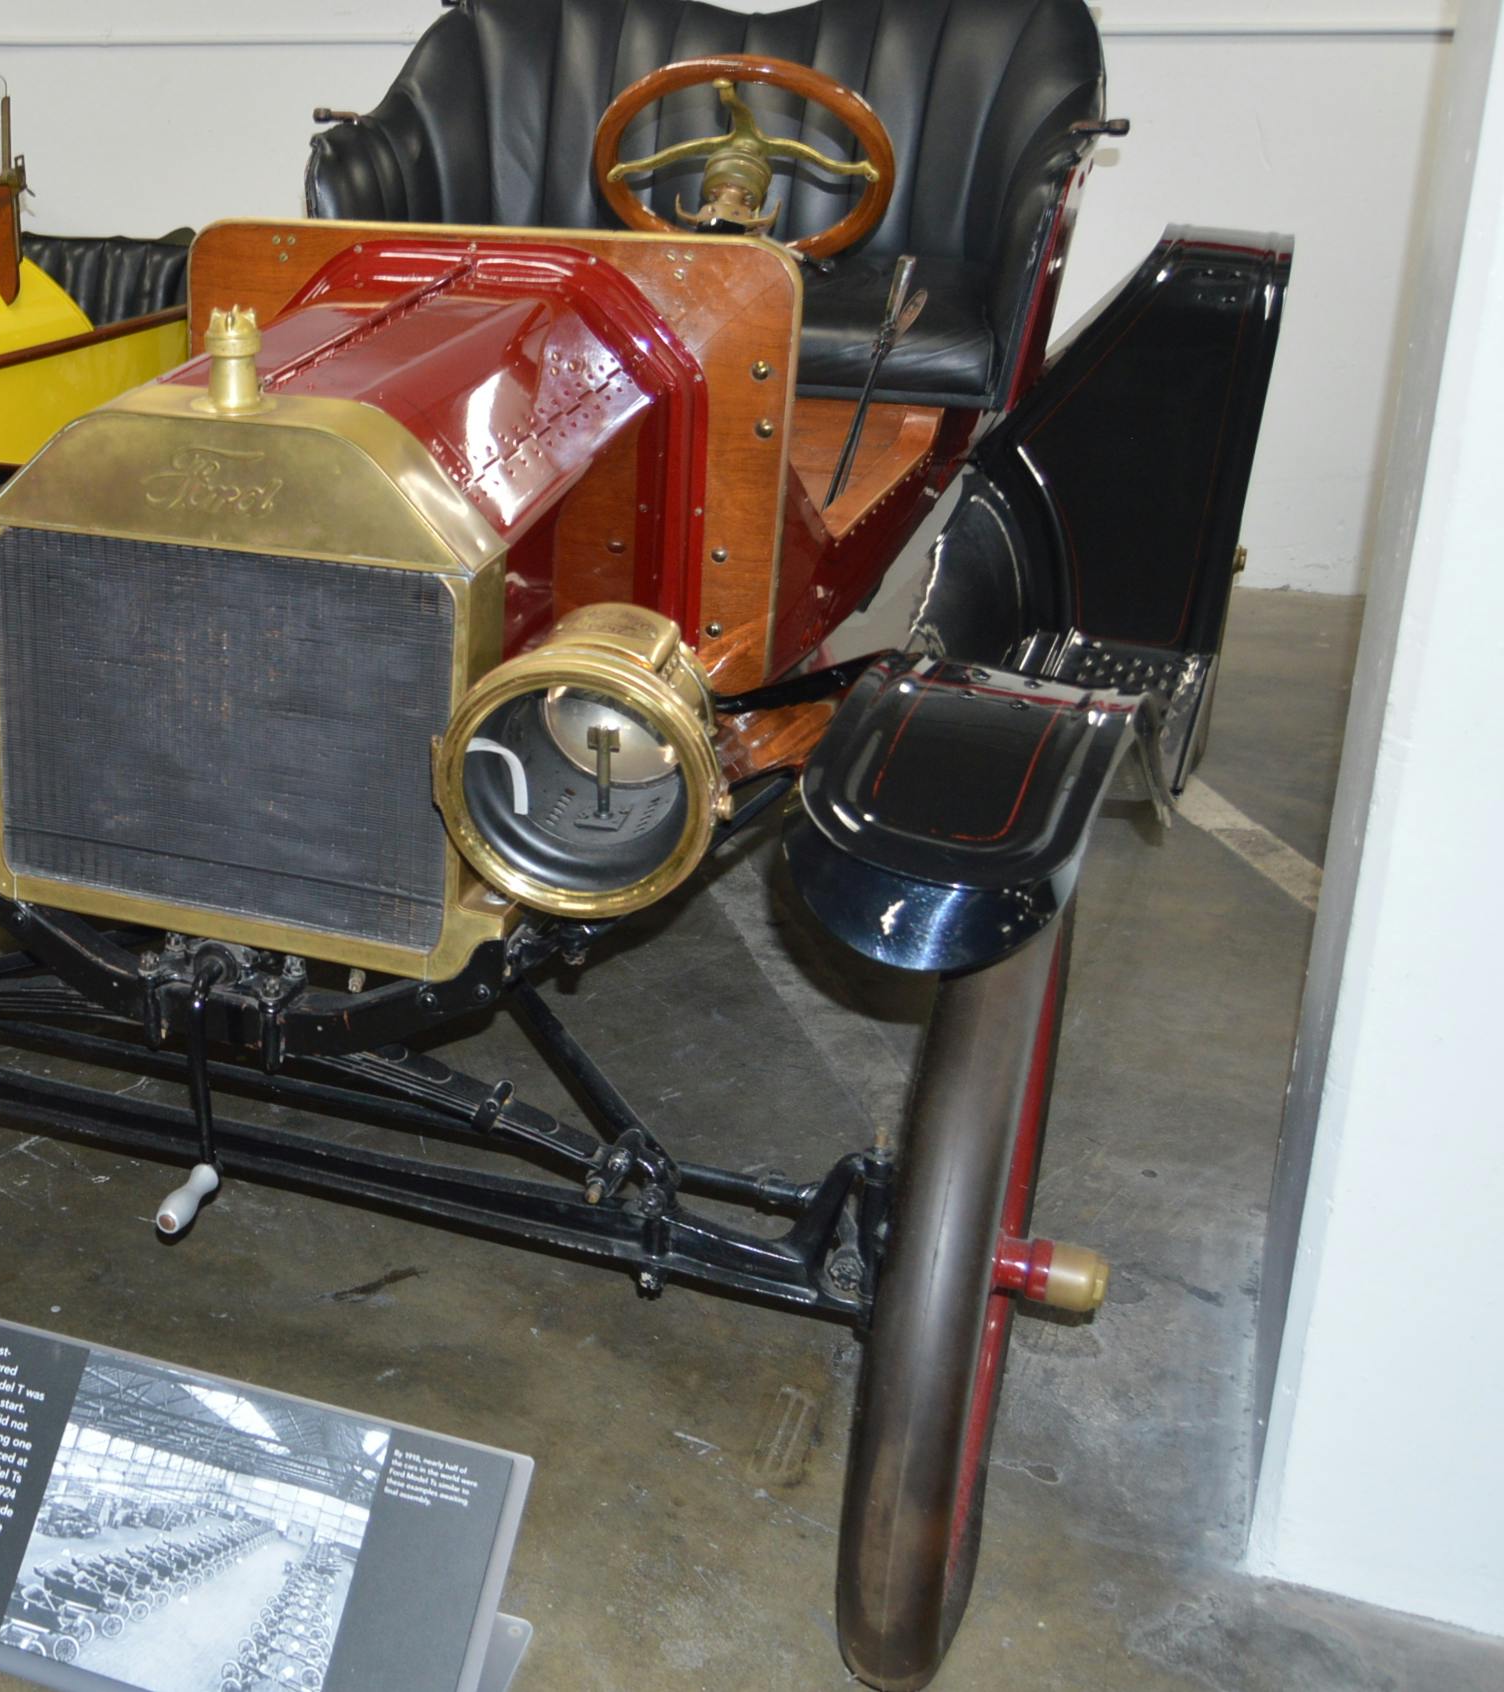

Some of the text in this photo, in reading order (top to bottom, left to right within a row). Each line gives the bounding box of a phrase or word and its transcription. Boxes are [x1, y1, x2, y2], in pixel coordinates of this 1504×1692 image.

[139, 445, 283, 518] Ford
[18, 1384, 25, 1395] T
[26, 1389, 45, 1401] was
[0, 1400, 25, 1413] start.
[10, 1420, 28, 1432] not
[12, 1438, 32, 1450] one
[17, 1457, 28, 1467] at
[12, 1470, 22, 1483] Ts
